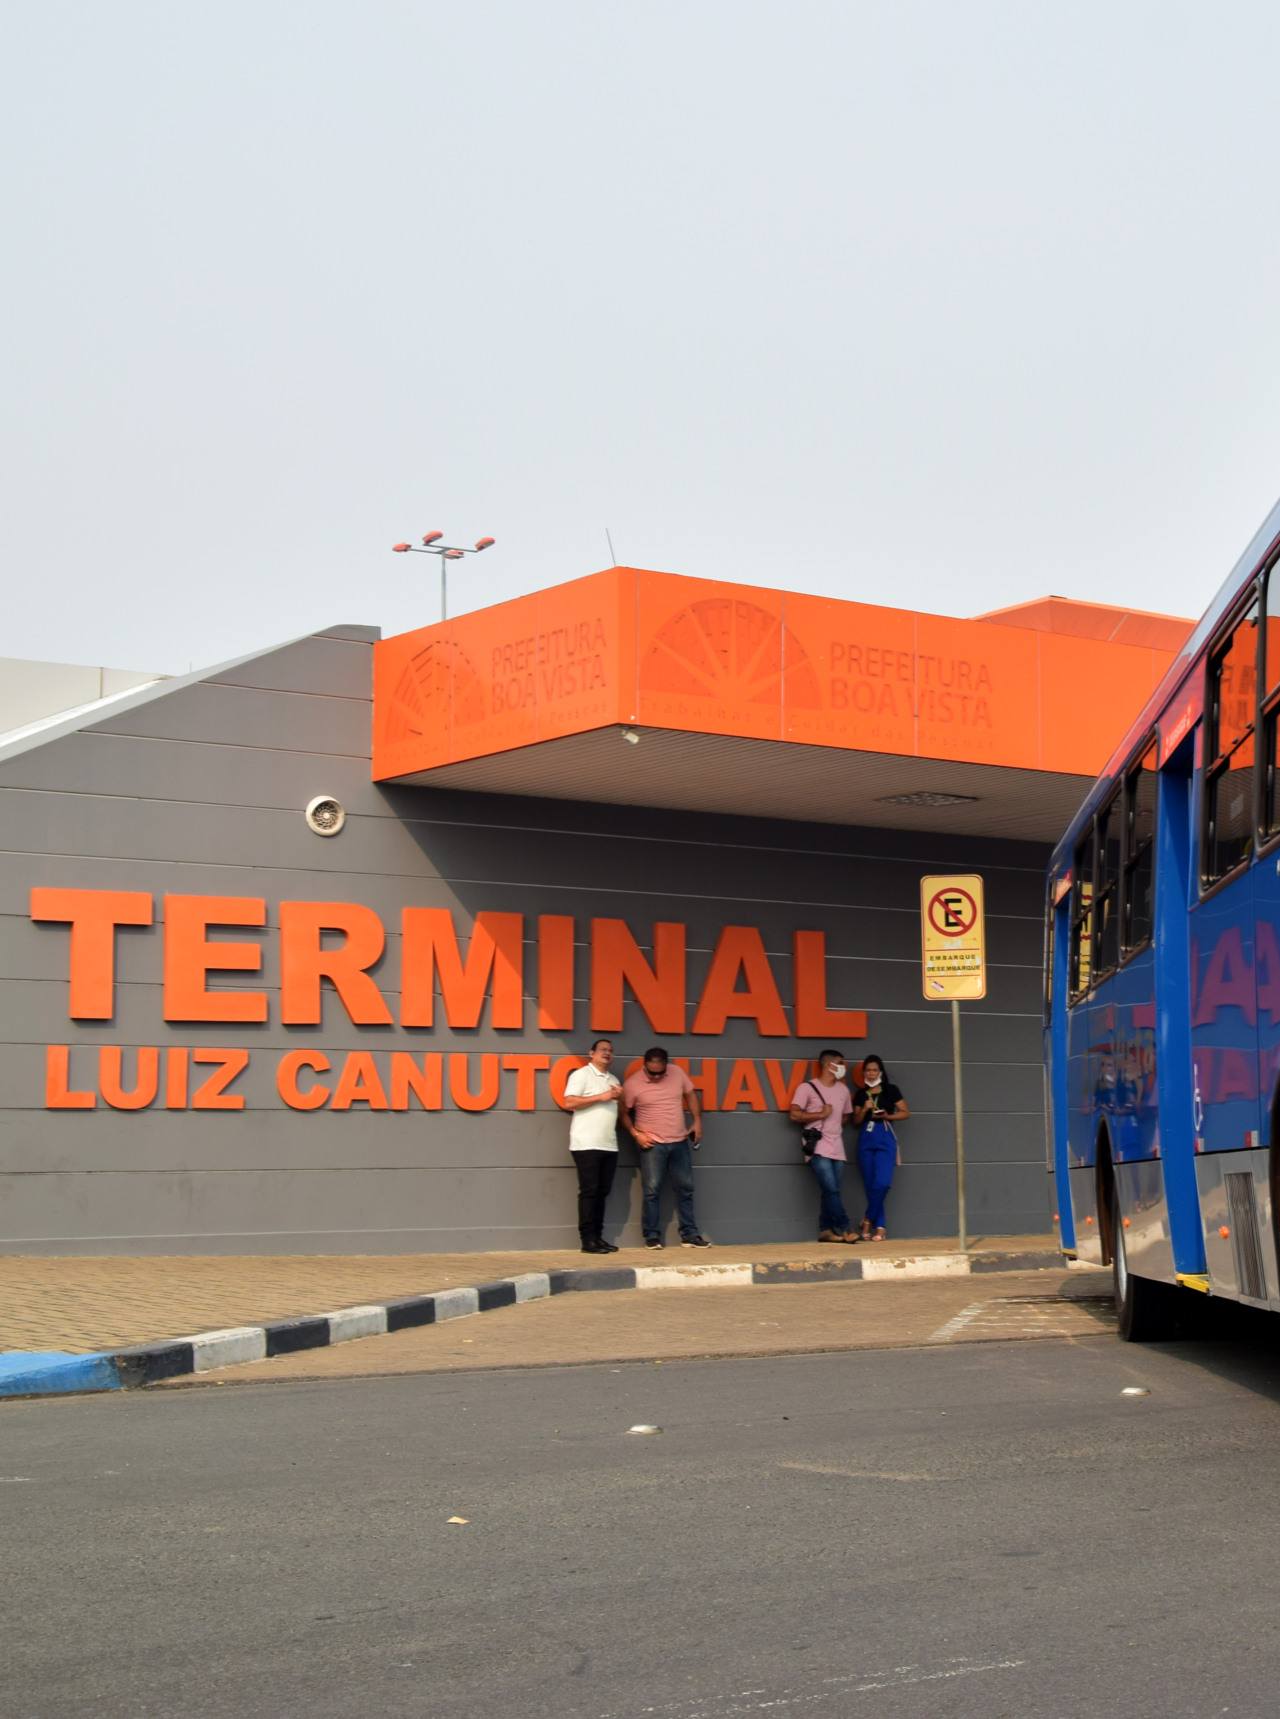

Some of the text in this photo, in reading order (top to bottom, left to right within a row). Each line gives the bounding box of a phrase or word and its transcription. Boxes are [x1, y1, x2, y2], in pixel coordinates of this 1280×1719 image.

[492, 617, 607, 678] PREFEITURA
[830, 641, 994, 693] PREFEITURA
[492, 654, 607, 715] BOA VISTA
[830, 677, 993, 729] BOA VISTA
[30, 886, 868, 1038] TERMINAL
[926, 964, 980, 972] DESEMBARQUE
[45, 1044, 249, 1110] LUIZ
